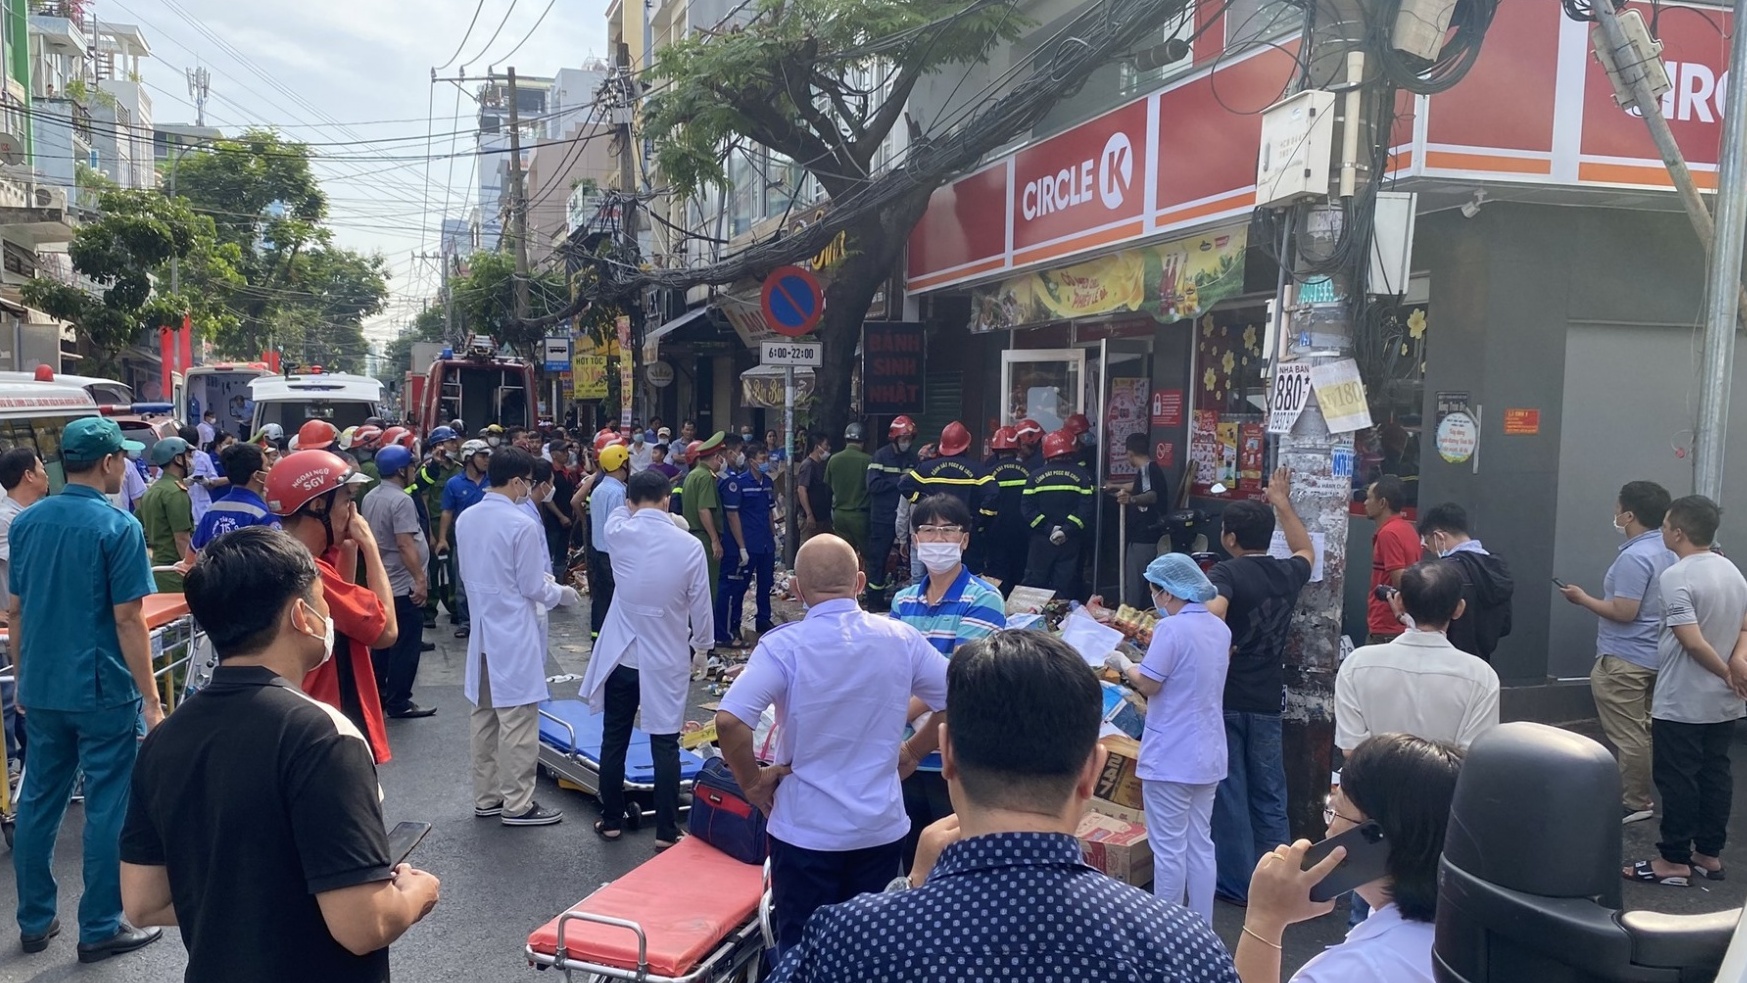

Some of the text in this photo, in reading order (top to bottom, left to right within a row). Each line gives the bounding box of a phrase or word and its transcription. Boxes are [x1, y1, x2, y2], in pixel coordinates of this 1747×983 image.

[1023, 159, 1094, 221] CIRCLE
[869, 330, 920, 352] BÁNH
[768, 347, 814, 360] 6:00-22:00
[873, 358, 917, 376] SINH
[869, 380, 920, 406] NHẬT
[1274, 374, 1302, 411] 880
[302, 475, 325, 491] SGV
